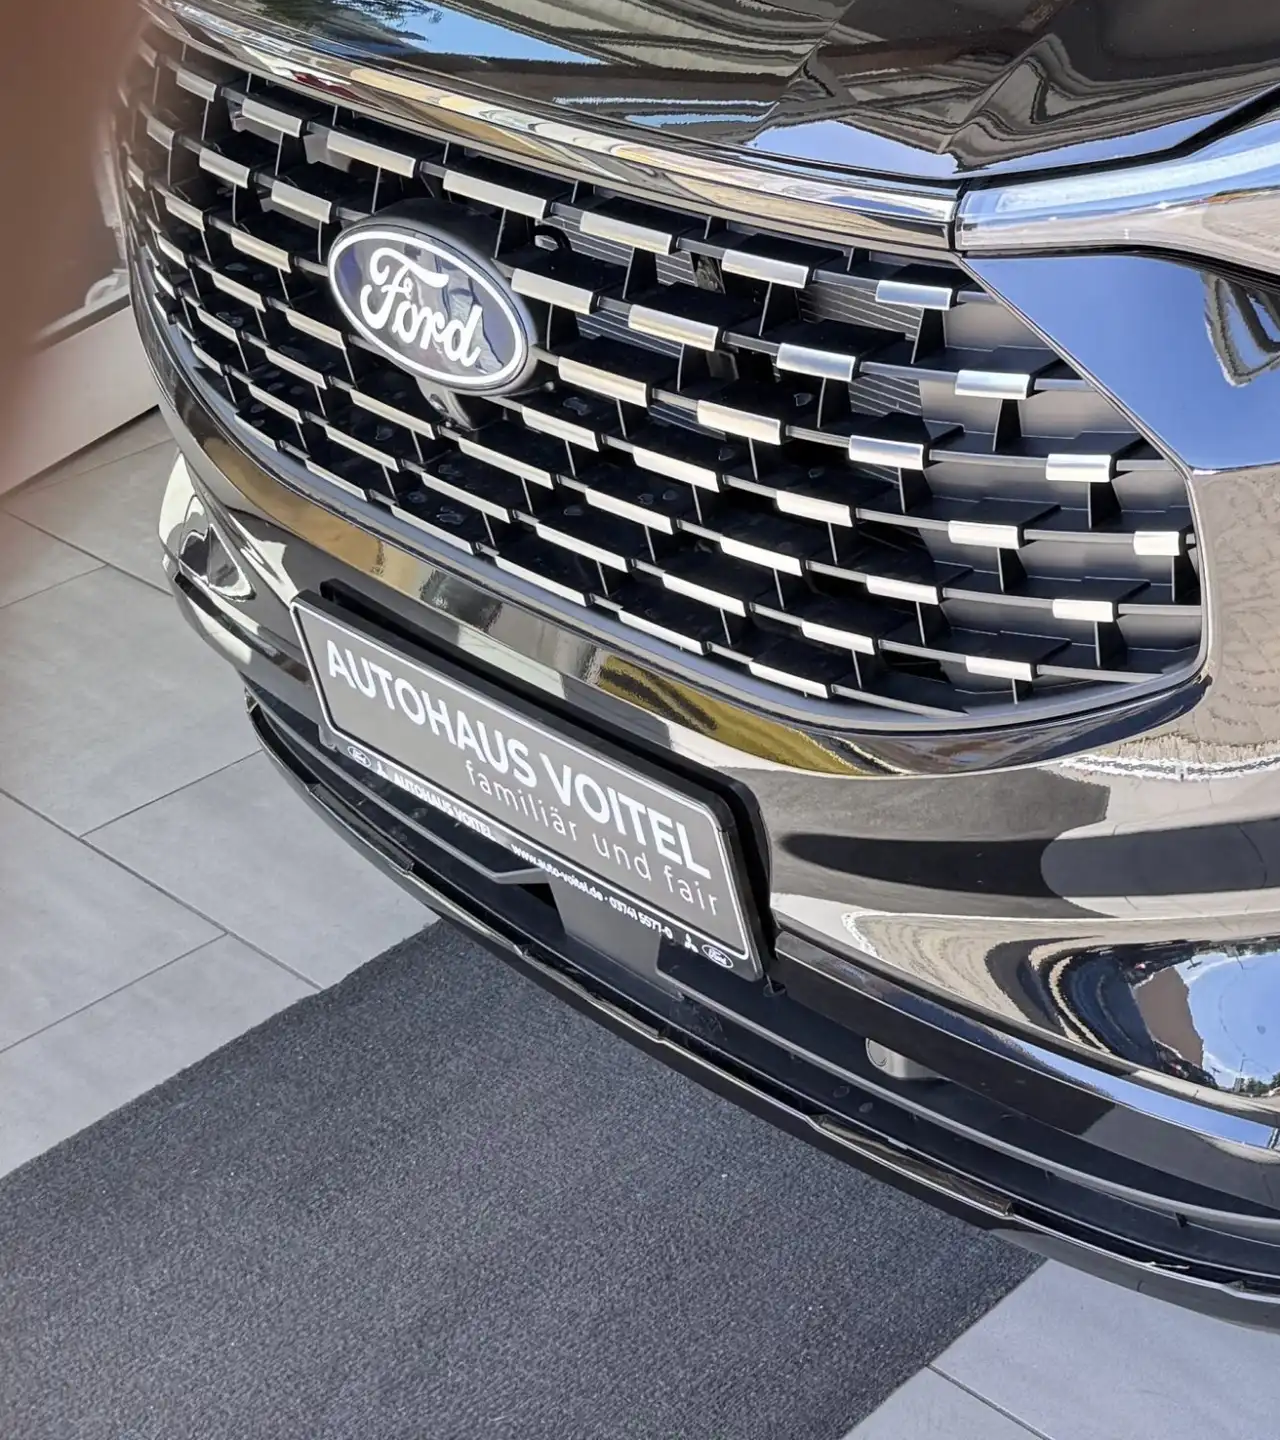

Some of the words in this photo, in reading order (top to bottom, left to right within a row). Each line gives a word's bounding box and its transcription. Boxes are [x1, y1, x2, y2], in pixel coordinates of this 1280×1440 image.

[359, 247, 483, 367] Ford
[327, 639, 537, 789] AUTOHAUS
[540, 752, 712, 880] VOITEL
[465, 759, 578, 842] familiär
[592, 833, 652, 882] und
[663, 864, 719, 916] fair
[511, 843, 604, 902] www.auto-voitel.de
